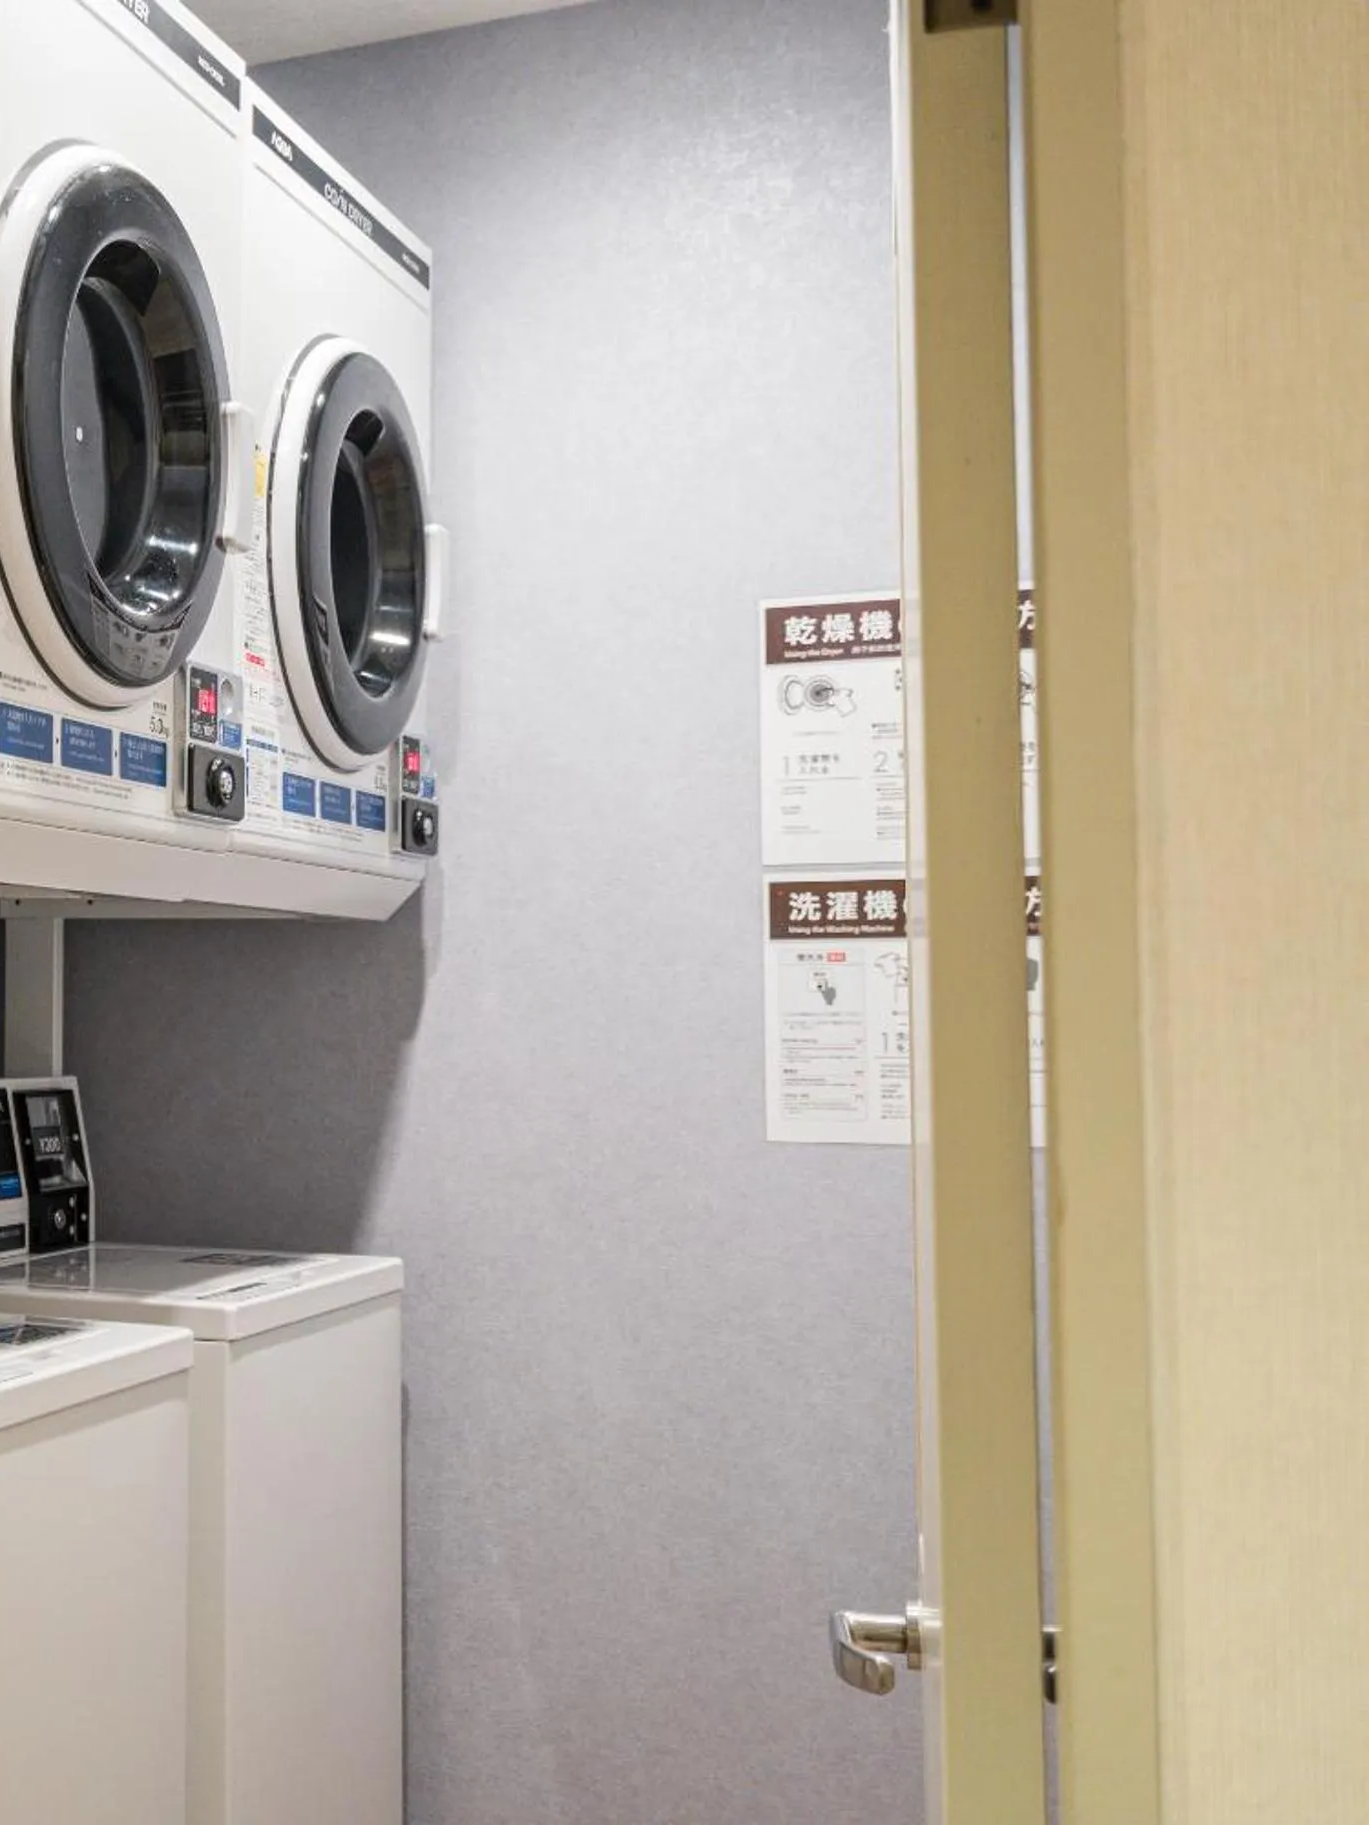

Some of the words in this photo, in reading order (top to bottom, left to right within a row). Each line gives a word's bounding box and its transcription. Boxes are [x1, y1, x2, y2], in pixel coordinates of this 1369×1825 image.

[784, 610, 902, 646] 乾燥機
[789, 889, 905, 921] 洗濯機
